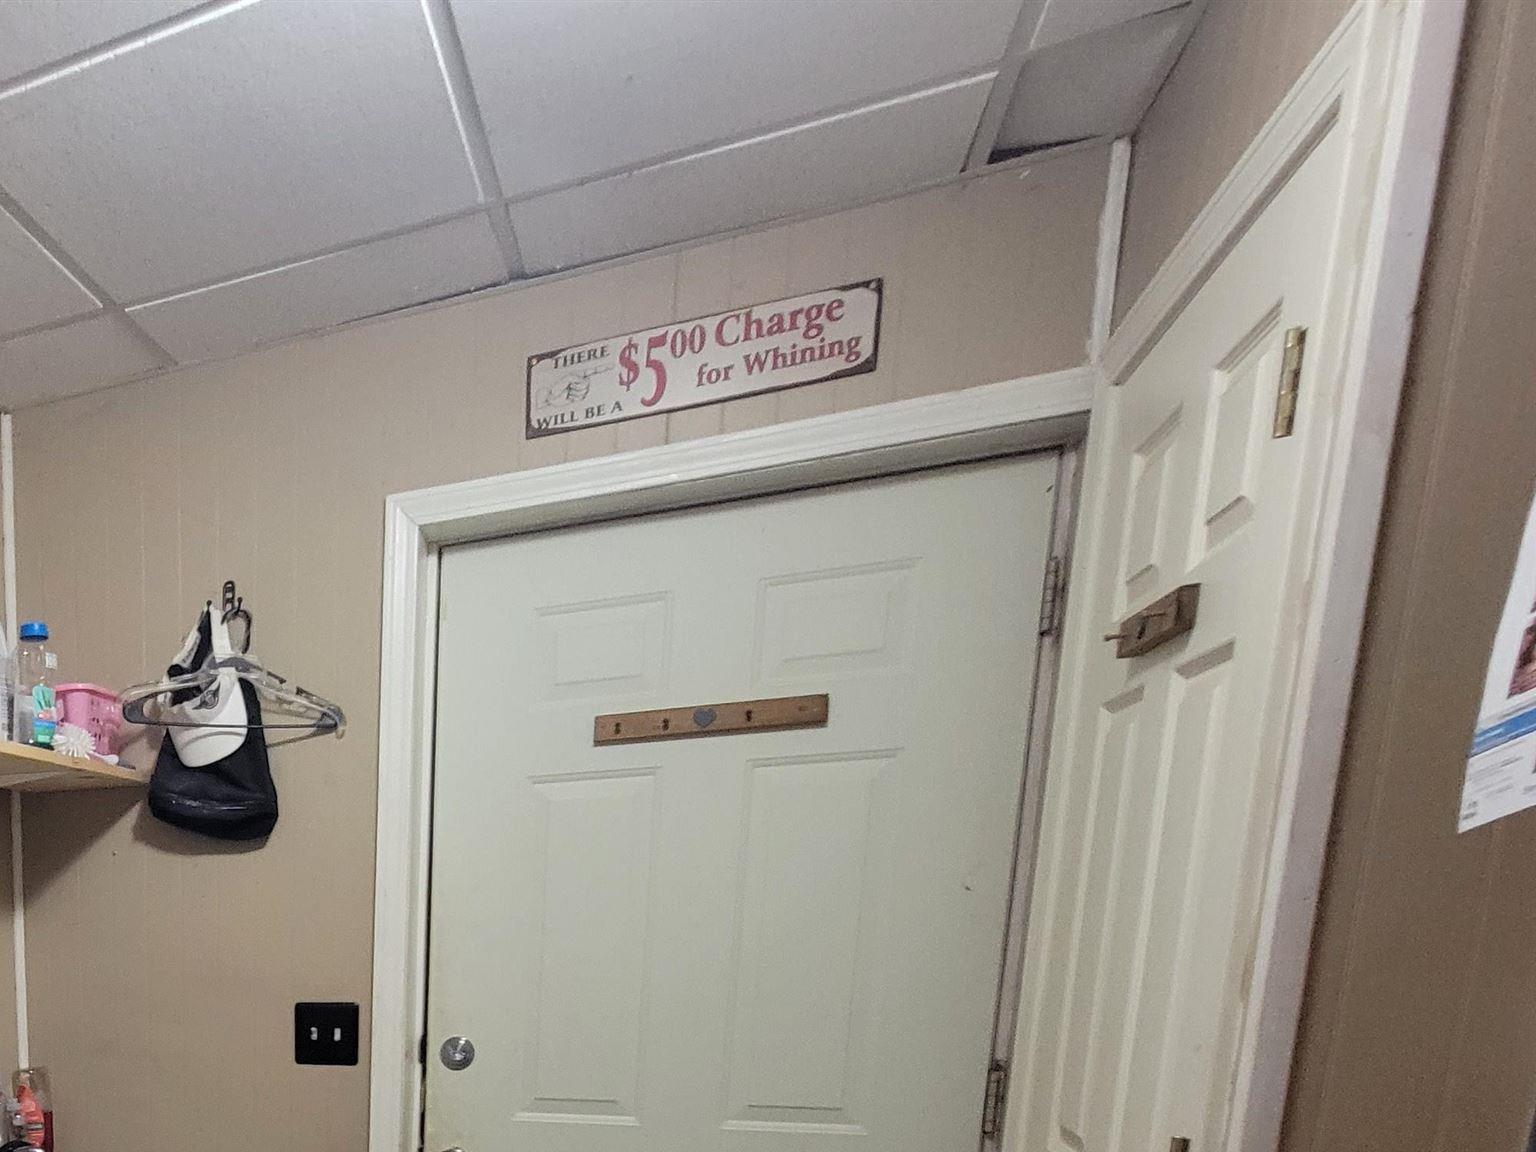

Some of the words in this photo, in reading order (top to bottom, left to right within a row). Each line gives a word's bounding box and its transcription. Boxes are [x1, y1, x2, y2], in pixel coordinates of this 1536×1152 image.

[714, 297, 846, 348] Charge
[551, 344, 611, 371] THERE
[695, 360, 734, 388] for
[743, 334, 863, 376] Whining
[536, 410, 580, 431] WILL
[584, 405, 608, 420] BE
[610, 400, 623, 414] A
